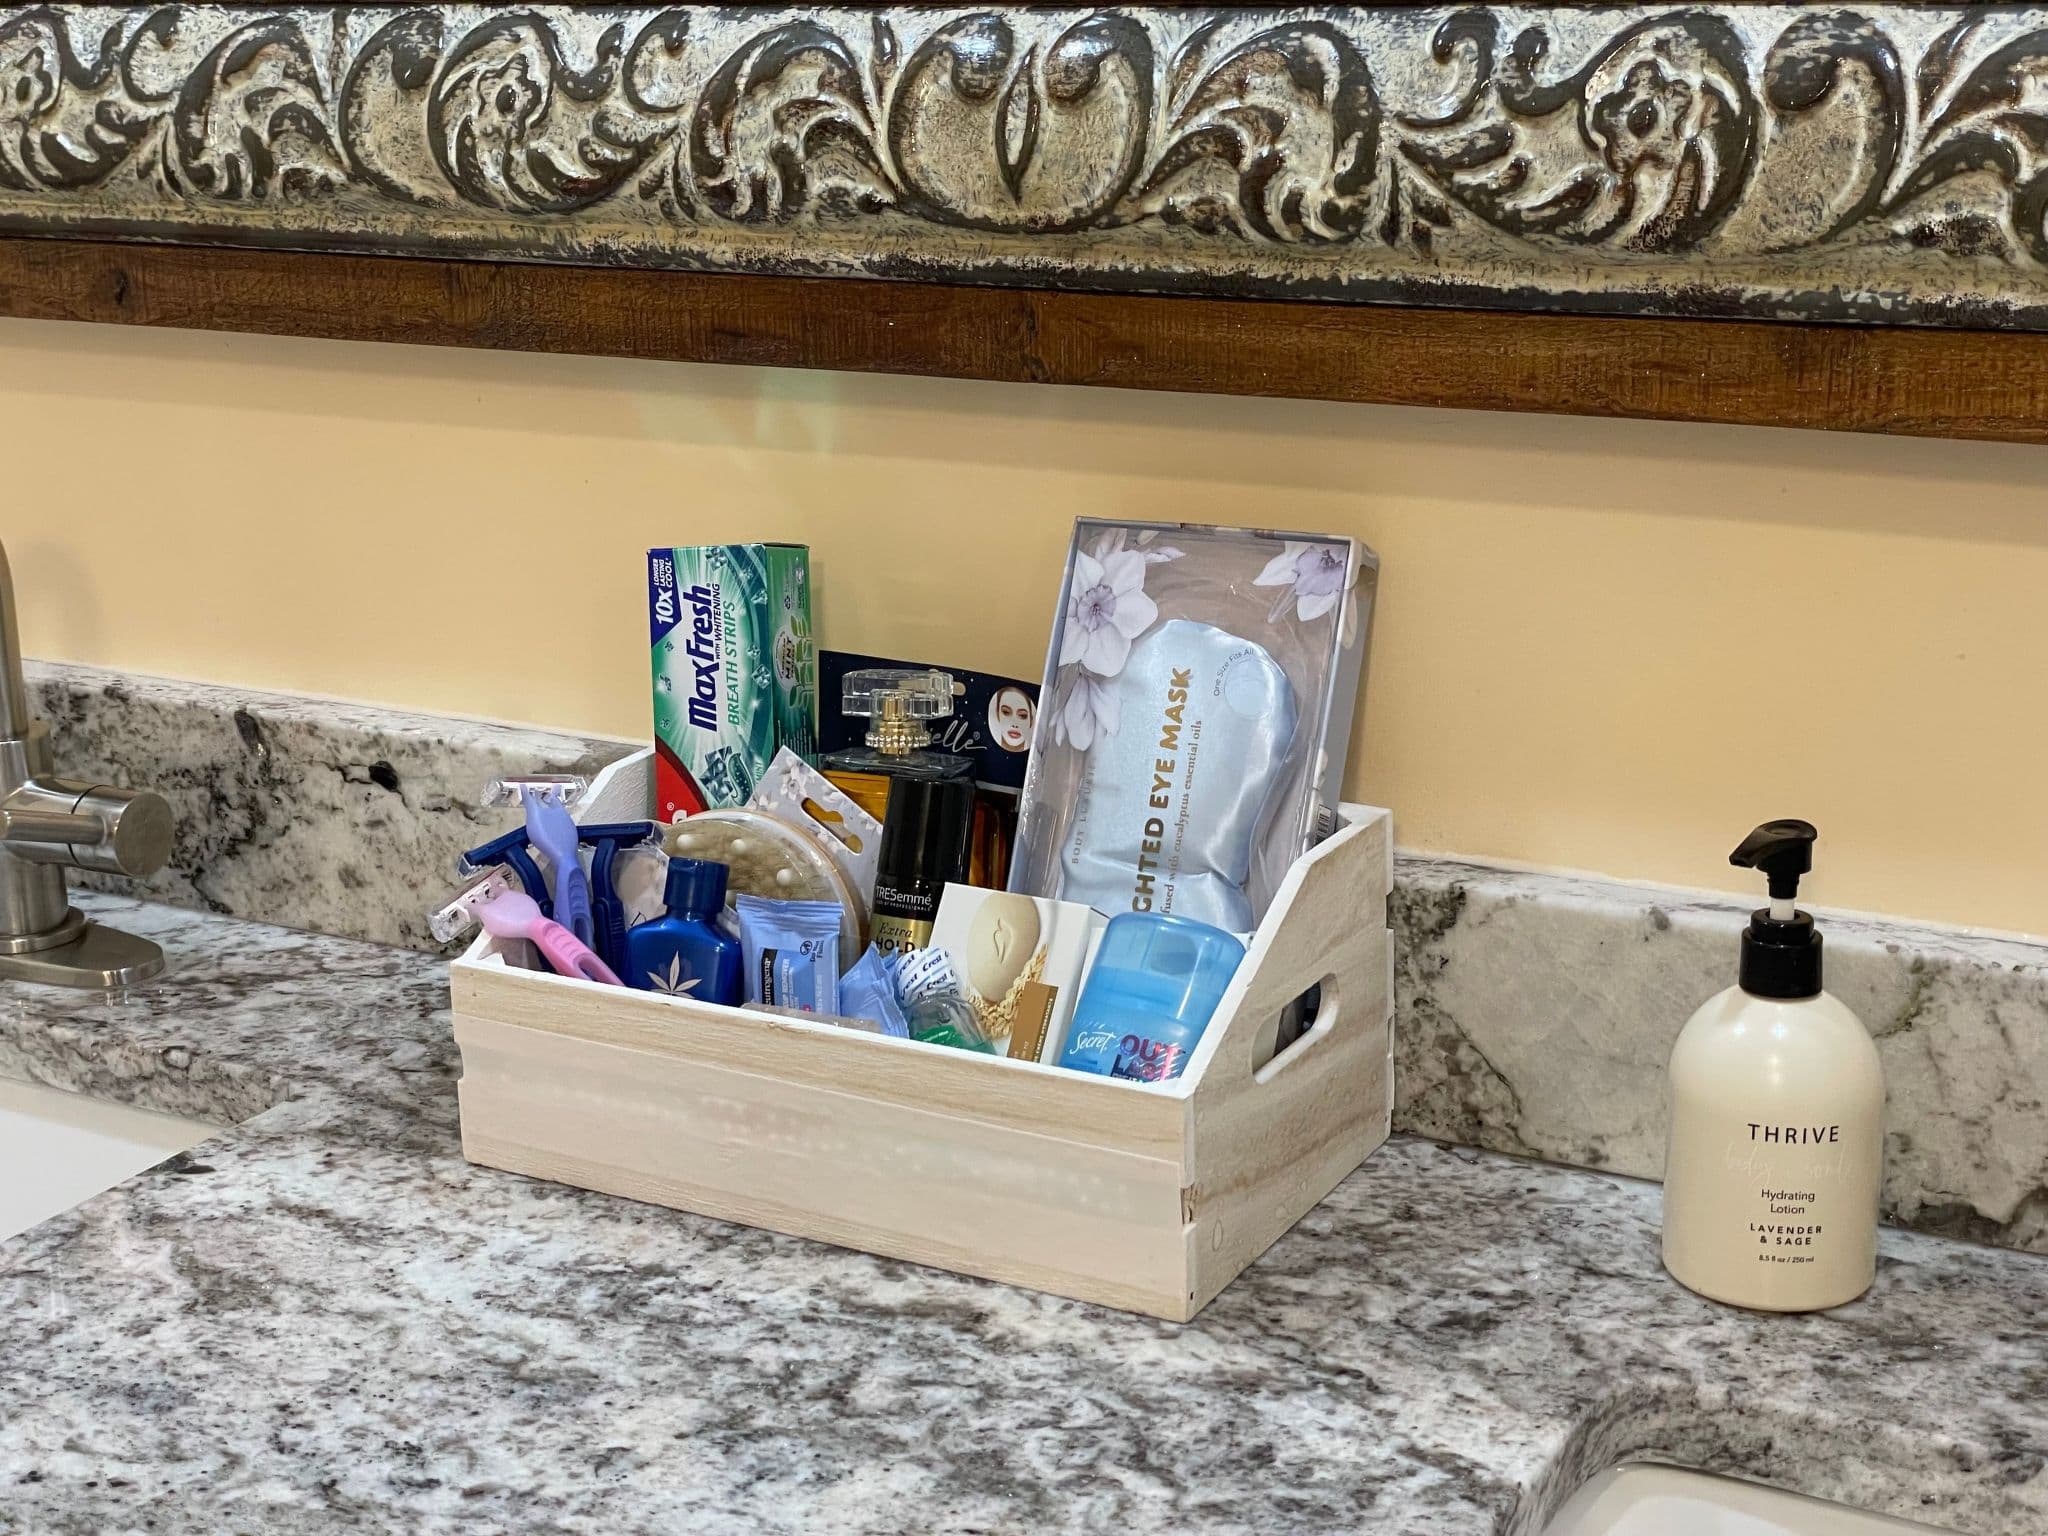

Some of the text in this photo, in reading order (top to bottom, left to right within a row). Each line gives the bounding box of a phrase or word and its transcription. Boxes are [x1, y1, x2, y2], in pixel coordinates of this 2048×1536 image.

[712, 583, 722, 641] WHITENING
[723, 600, 741, 726] BREATH STRIPS
[1190, 720, 1202, 740] oils
[1184, 742, 1199, 790] essential
[1132, 667, 1192, 913] GHTED EYE MASK
[1174, 793, 1190, 852] eucalyptus
[1160, 884, 1175, 914] fused
[880, 922, 913, 938] Extra
[922, 954, 943, 972] Crest
[764, 960, 773, 1006] eutrogena
[1069, 1031, 1117, 1055] Secret
[1747, 1123, 1840, 1145] THRIVE
[1761, 1188, 1816, 1203] Hydrating
[1770, 1203, 1805, 1214] Lotion
[1750, 1222, 1822, 1235] LAVENDER
[1760, 1235, 1812, 1246] & SAGE
